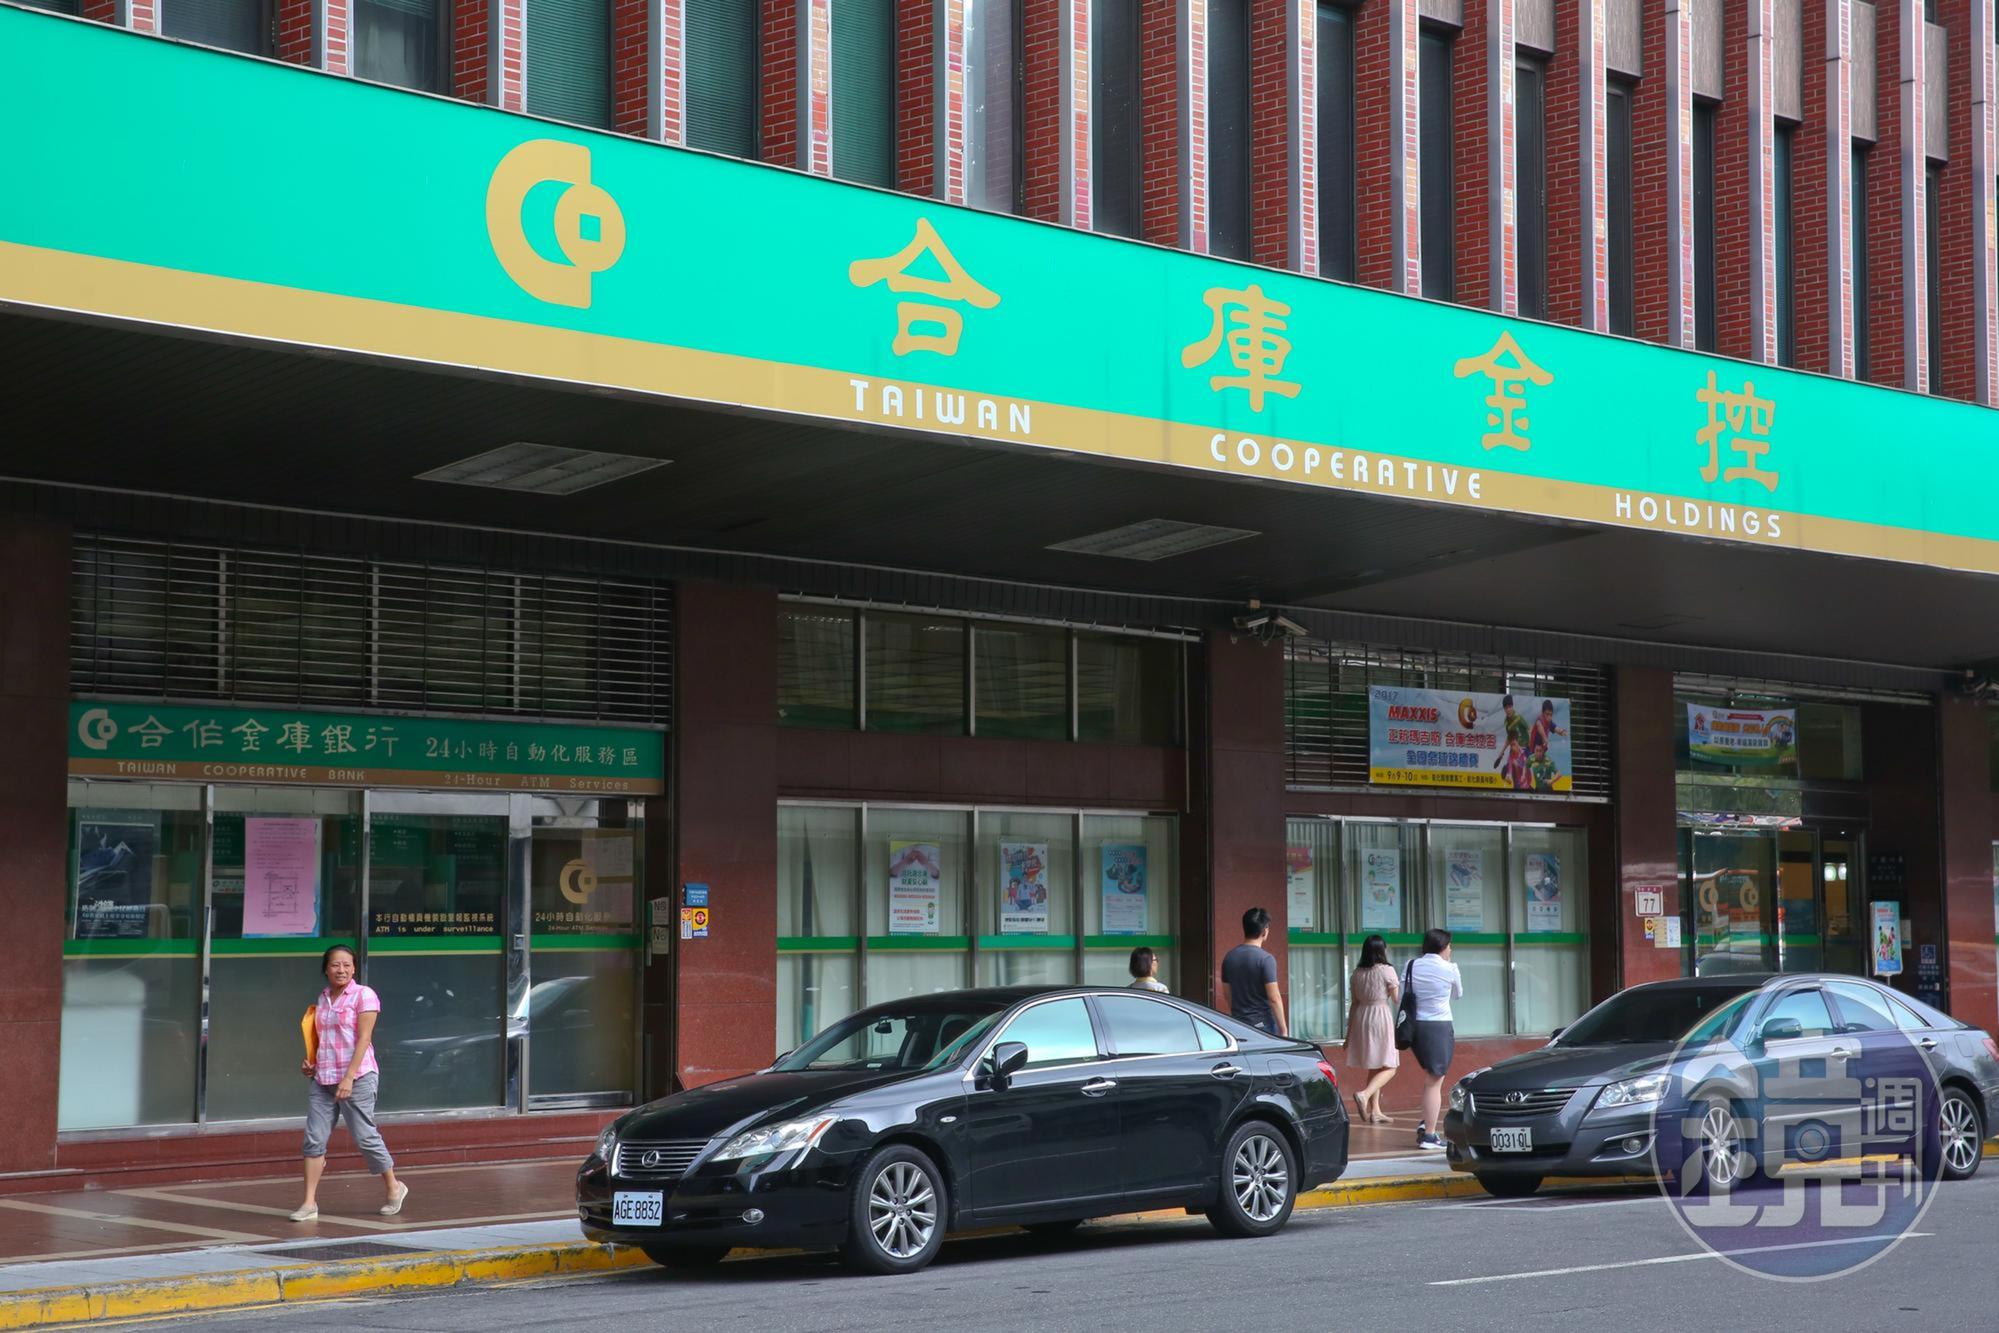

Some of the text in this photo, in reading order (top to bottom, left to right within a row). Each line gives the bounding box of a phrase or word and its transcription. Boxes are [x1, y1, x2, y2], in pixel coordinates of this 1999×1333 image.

[849, 217, 1779, 491] 合庫金控
[850, 378, 1782, 539] TAIWAN COOPERATIVE HOLDINGS
[1374, 689, 1399, 702] 2017
[1388, 704, 1438, 722] MAXXIS
[127, 714, 400, 758] 合作金庫銀行
[425, 736, 639, 766] 24小時自動化服務區
[117, 761, 365, 780] TAIWAN COOPERATIVE BANK
[444, 774, 629, 791] 24-Hour ATM Services
[1643, 898, 1656, 912] 77
[375, 925, 494, 933] ATM is under surveillance
[1491, 1132, 1532, 1149] 0031-QL
[614, 1200, 661, 1220] AGE-8832
